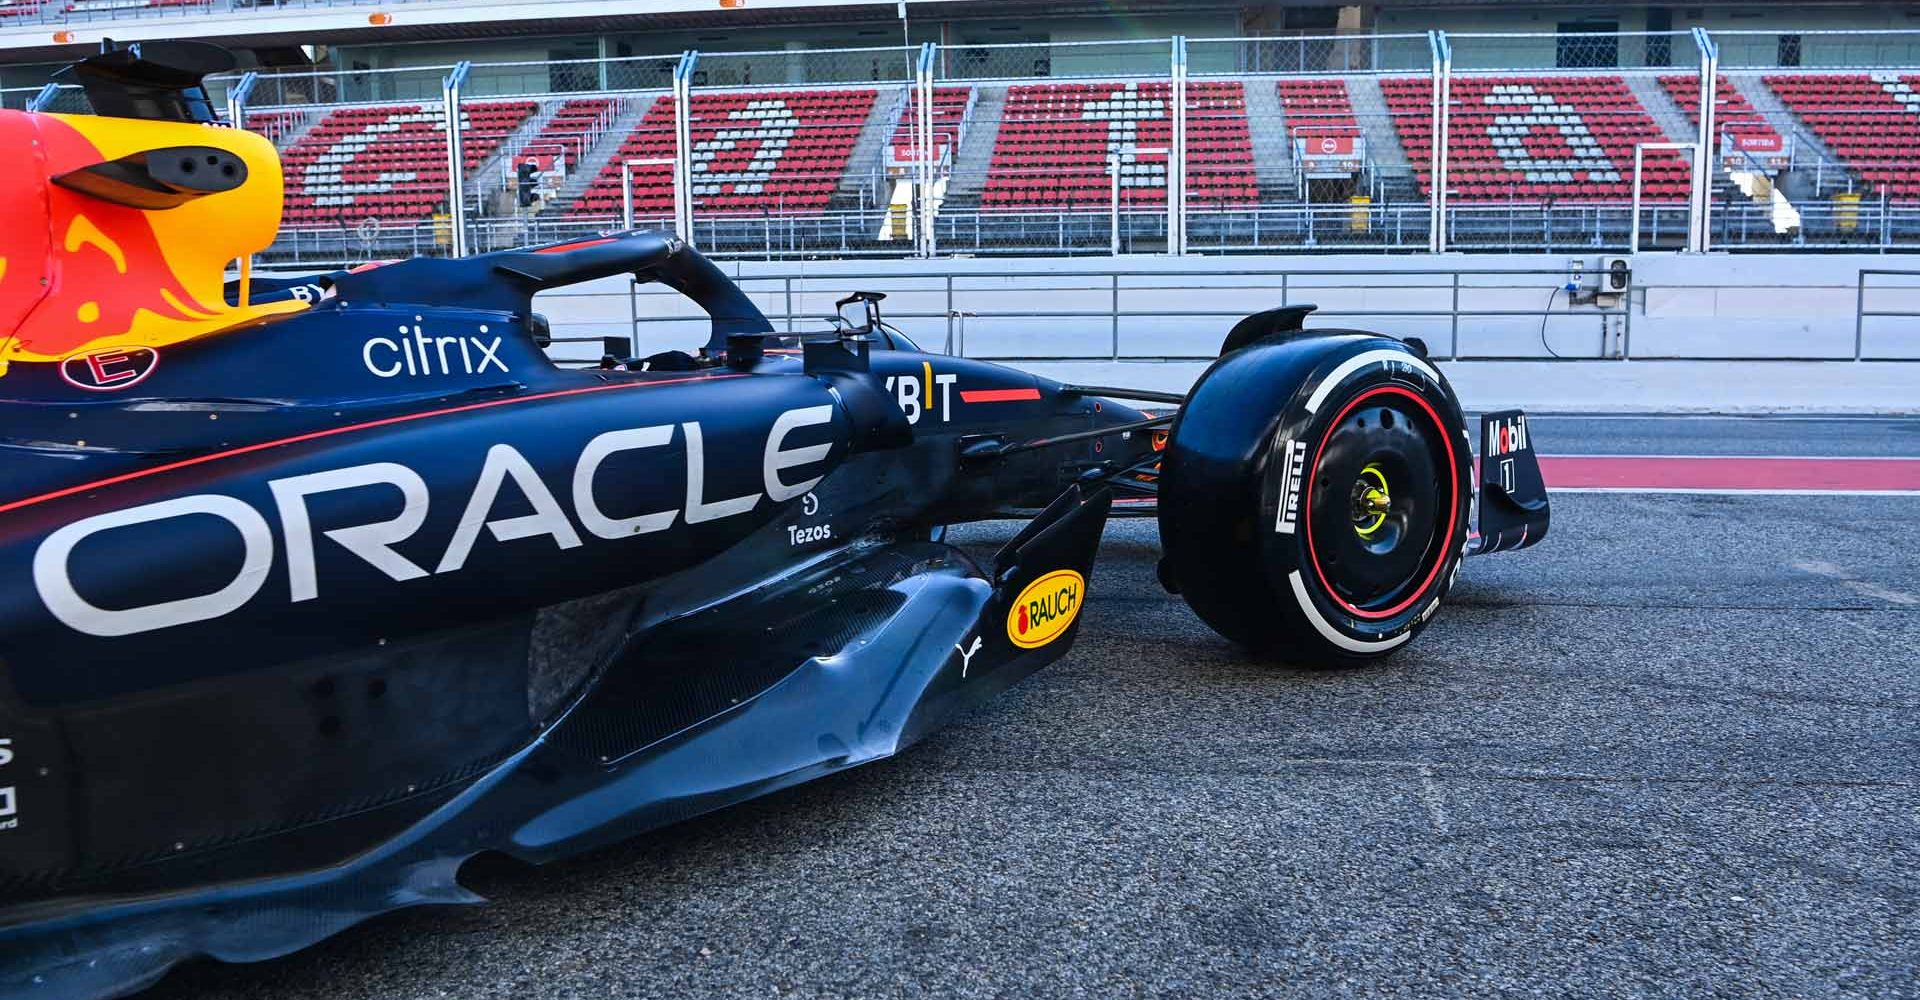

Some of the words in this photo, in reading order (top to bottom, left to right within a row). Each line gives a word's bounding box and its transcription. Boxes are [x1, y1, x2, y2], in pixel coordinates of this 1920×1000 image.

[86, 350, 137, 385] E
[363, 315, 509, 377] citrix
[1488, 415, 1527, 457] Mobil
[1275, 439, 1307, 534] PIRELLI
[33, 404, 834, 637] ORACLE
[787, 524, 831, 546] Tezos
[1030, 582, 1077, 630] RAUCH
